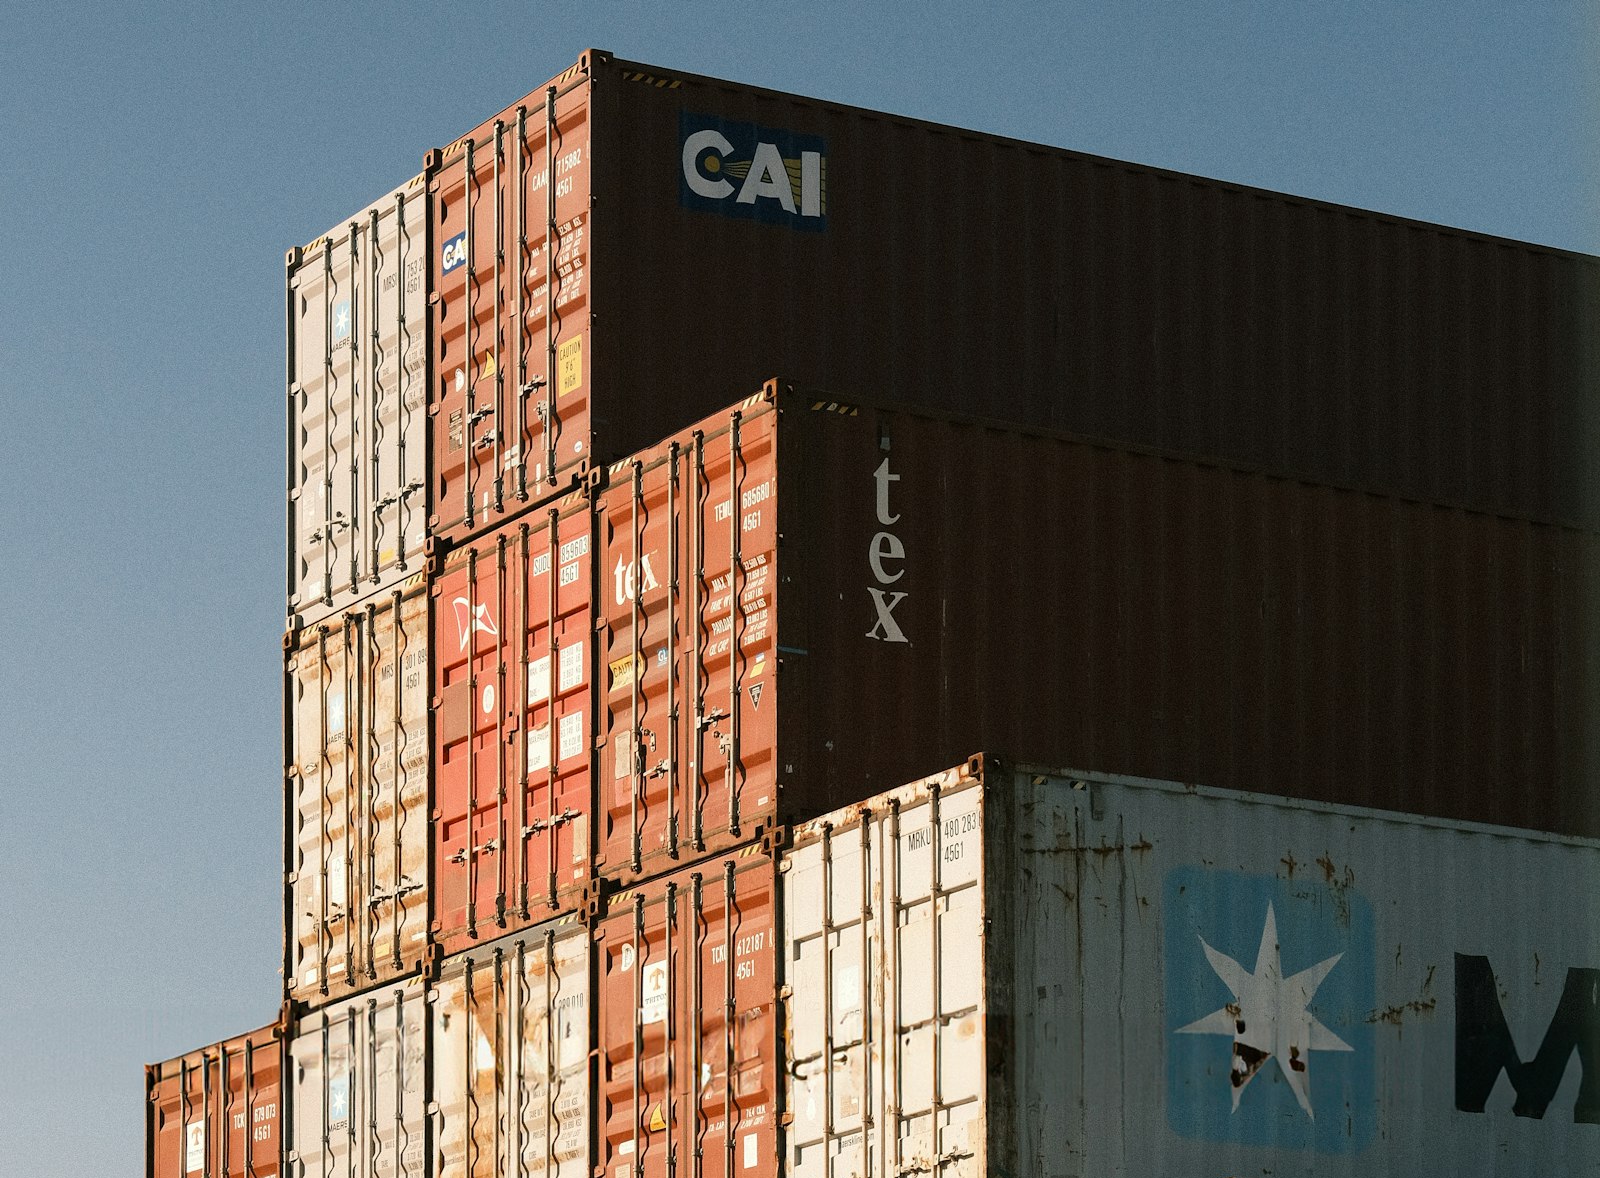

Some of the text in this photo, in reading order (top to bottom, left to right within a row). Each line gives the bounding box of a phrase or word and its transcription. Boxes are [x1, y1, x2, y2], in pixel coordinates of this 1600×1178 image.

[682, 130, 820, 217] CAI
[556, 176, 572, 198] 45G1
[443, 238, 466, 269] CA
[407, 276, 421, 295] 45G1
[560, 341, 580, 360] CAUTION
[743, 482, 770, 509] 685680
[743, 510, 761, 532] 45G1
[561, 537, 587, 562] 859603
[864, 457, 910, 643] tex
[561, 565, 578, 584] 45G1
[614, 553, 660, 606] tex
[712, 616, 732, 636] PAYLOA
[381, 663, 394, 681] MRS
[405, 672, 420, 690] 45G1
[909, 813, 976, 852] MRKU 480 283
[944, 841, 964, 863] 45G1
[737, 932, 764, 957] 612187
[737, 960, 755, 980] 45G1
[234, 1114, 245, 1130] TCK
[254, 1124, 271, 1142] 45G1
